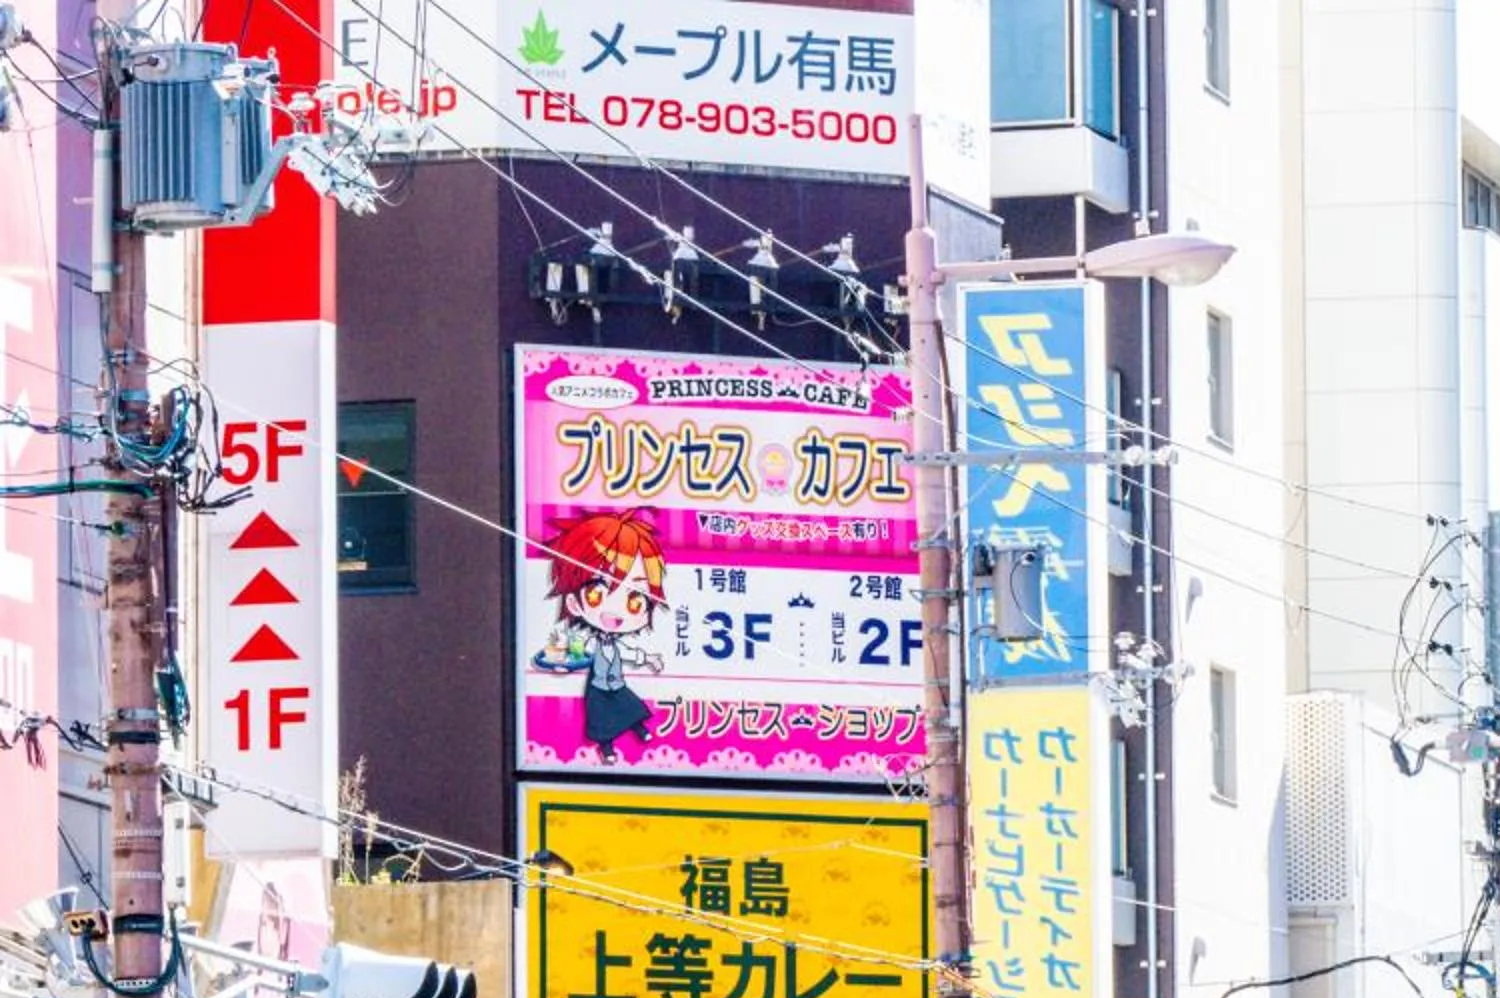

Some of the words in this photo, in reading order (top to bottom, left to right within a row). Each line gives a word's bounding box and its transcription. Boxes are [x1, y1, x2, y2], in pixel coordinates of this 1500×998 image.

[582, 22, 897, 96] メープル有馬
[516, 89, 591, 124] TEL
[603, 95, 896, 145] 078-903-5000
[648, 378, 775, 400] PRINCESS
[803, 382, 871, 411] CAFE
[221, 420, 307, 484] 5F
[560, 419, 753, 501] プリンセス
[798, 432, 911, 504] カフェ
[694, 568, 747, 595] 1号館
[849, 574, 903, 600] 2号館
[702, 610, 773, 660] 3F
[859, 619, 924, 667] 2F
[224, 687, 309, 751] 1F
[657, 697, 788, 740] プリンセス
[818, 702, 922, 744] ショップ
[680, 854, 789, 917] 福島
